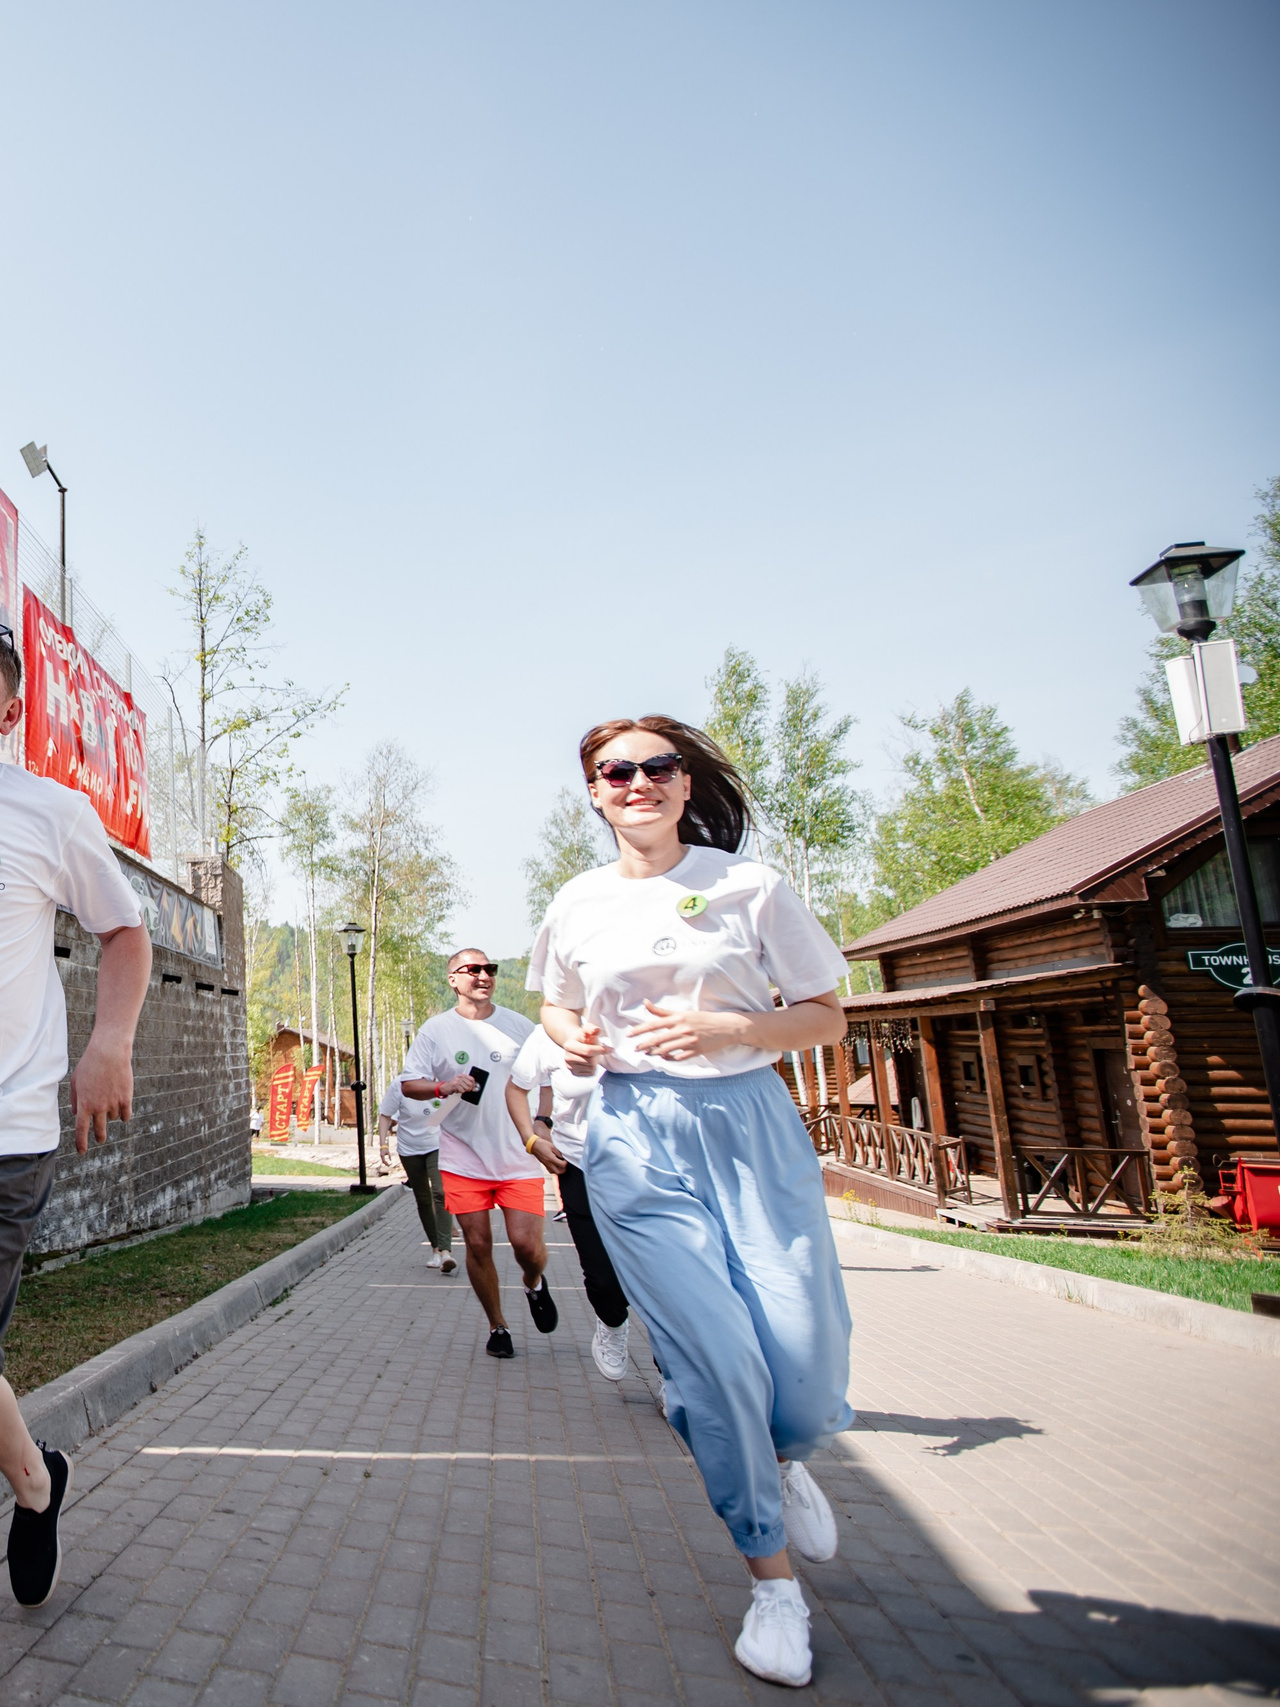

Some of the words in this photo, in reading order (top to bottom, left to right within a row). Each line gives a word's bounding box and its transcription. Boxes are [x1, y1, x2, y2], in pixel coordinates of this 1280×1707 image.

[683, 896, 699, 911] 4
[276, 1085, 289, 1130] СТАРТ
[298, 1081, 312, 1121] СТАРТ
